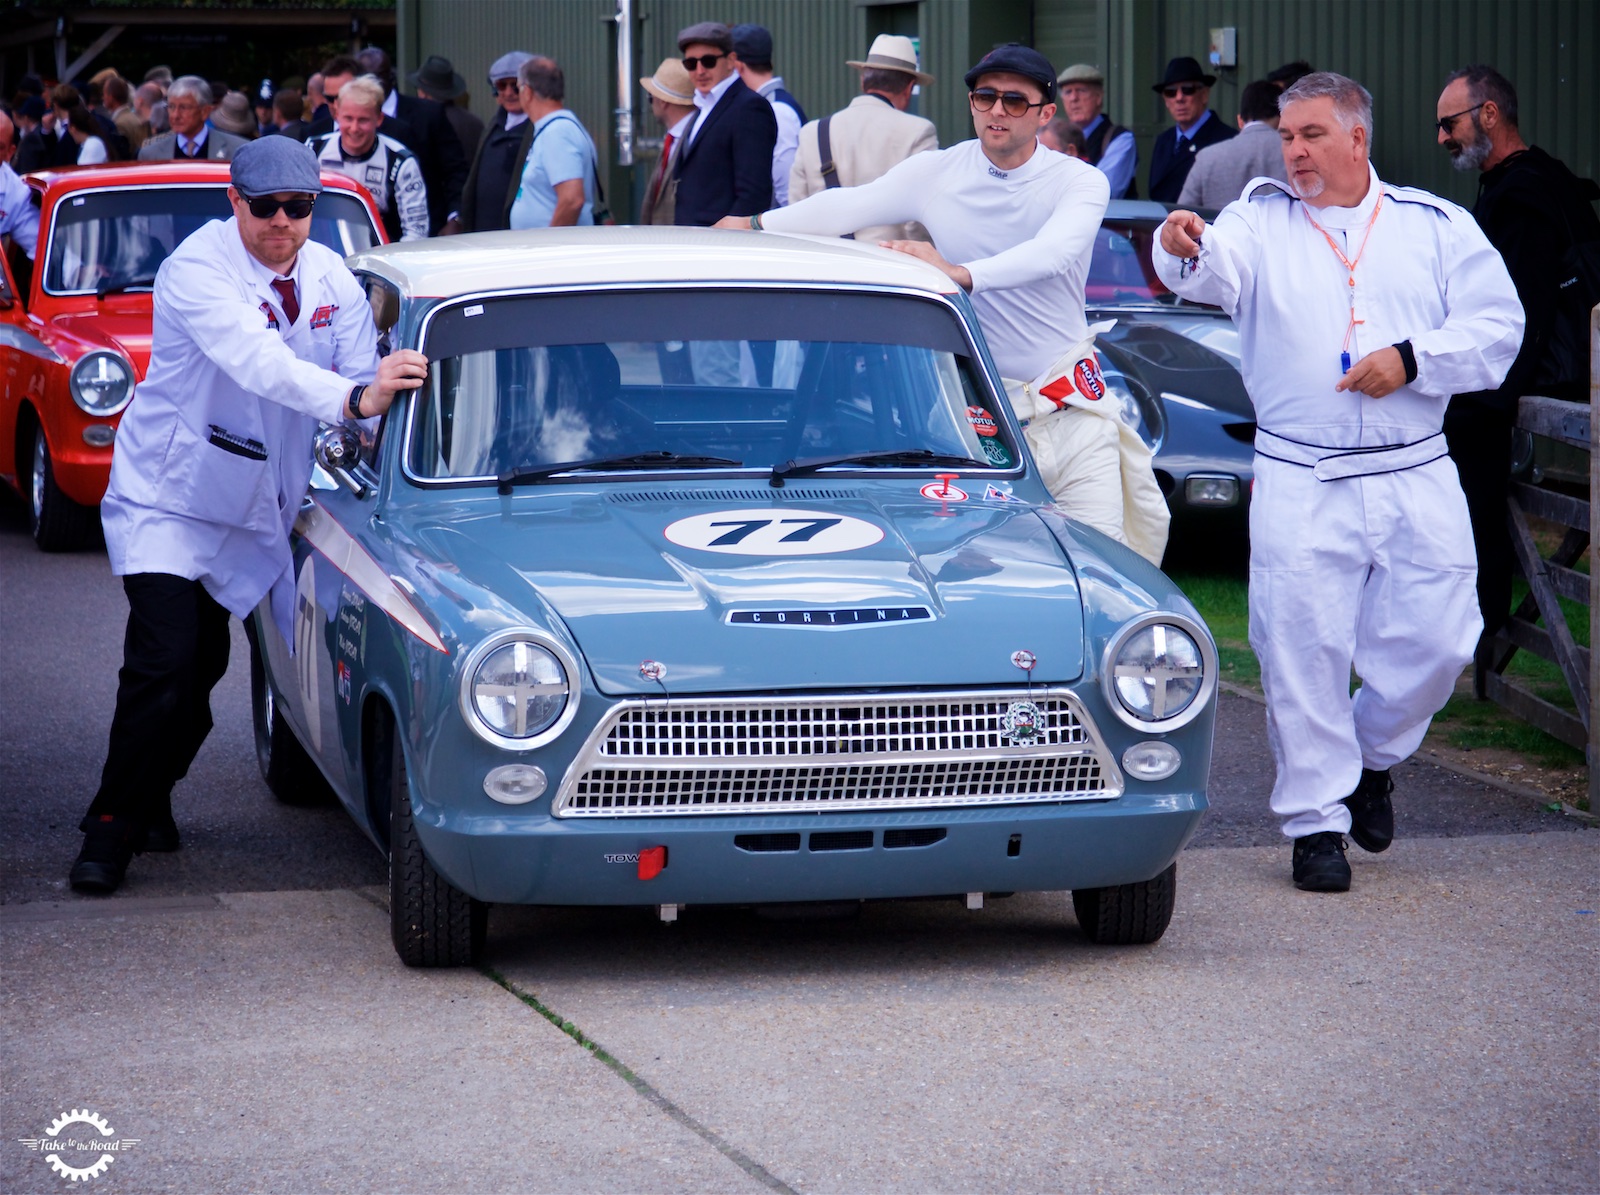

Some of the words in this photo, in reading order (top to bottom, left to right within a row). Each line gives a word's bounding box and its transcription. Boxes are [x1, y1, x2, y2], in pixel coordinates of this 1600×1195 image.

[1079, 361, 1102, 398] MOTUL
[966, 416, 996, 426] MOTUL
[707, 518, 843, 547] 77
[753, 609, 911, 623] CORTINA
[603, 853, 641, 864] TOW
